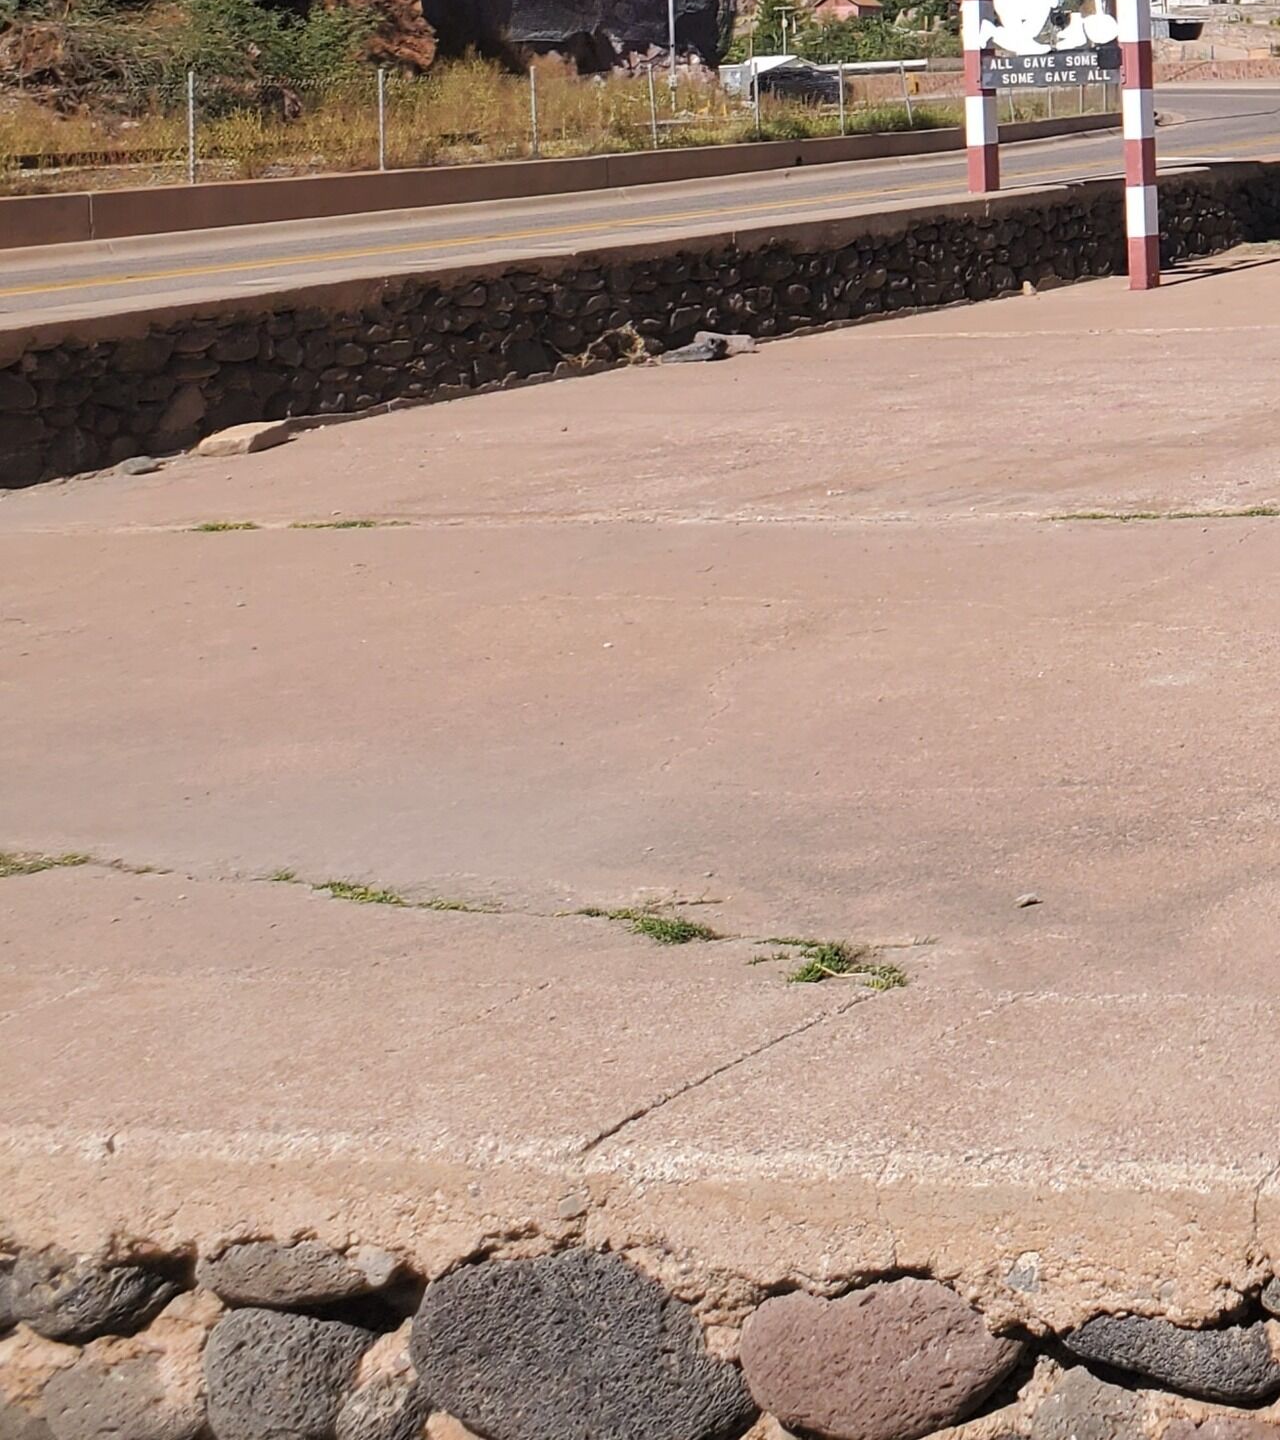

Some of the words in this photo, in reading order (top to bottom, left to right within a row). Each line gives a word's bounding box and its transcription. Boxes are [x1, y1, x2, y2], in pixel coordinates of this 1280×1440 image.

[990, 58, 1013, 70] ALL
[1024, 56, 1055, 68] GAVE
[1066, 55, 1098, 66] SOME
[1002, 72, 1034, 84] SOME
[1045, 70, 1077, 82] GAVE
[1087, 69, 1111, 81] ALL
